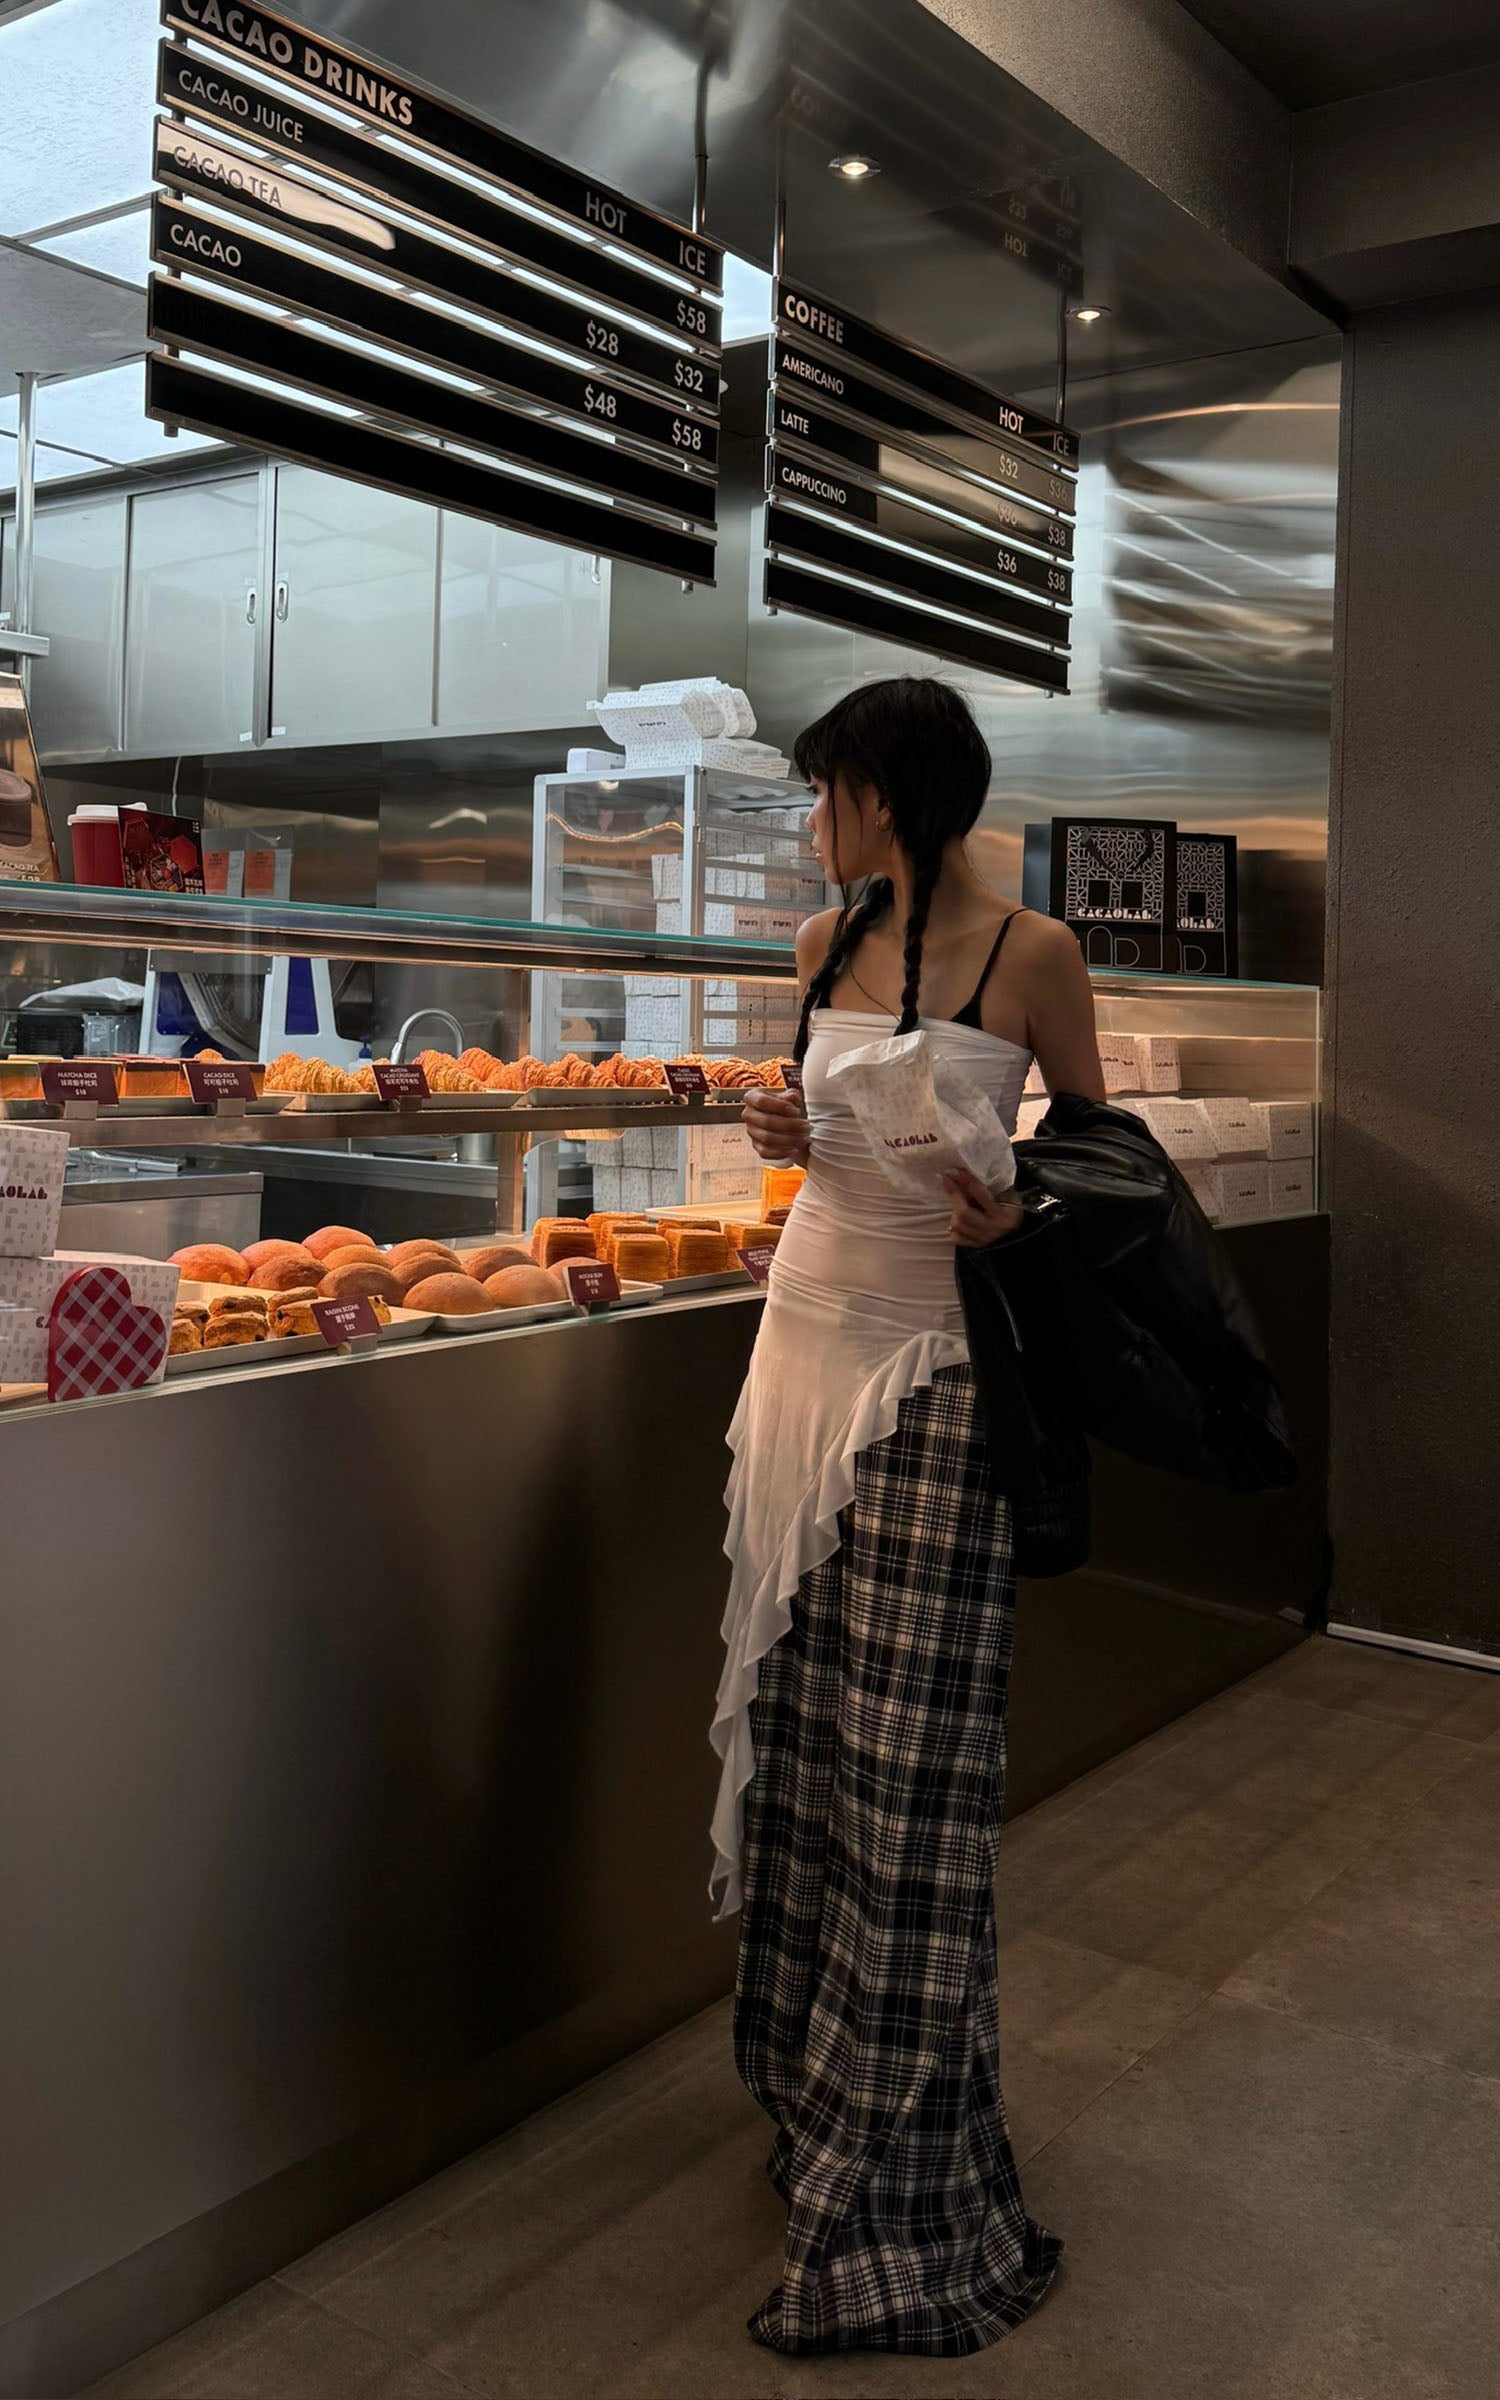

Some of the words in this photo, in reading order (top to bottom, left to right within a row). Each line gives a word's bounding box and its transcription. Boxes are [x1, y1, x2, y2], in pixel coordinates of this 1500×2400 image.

[178, 69, 249, 116] CACAO
[253, 103, 303, 143] JUICE
[677, 299, 706, 334] $58
[181, 0, 293, 64] CACAO
[303, 46, 413, 126] DRINKS
[586, 191, 627, 234] HOT
[679, 240, 705, 275] ICE
[170, 223, 242, 267] CACAO
[584, 384, 617, 418] $48
[672, 419, 701, 450] $58
[174, 146, 243, 189] CACAO
[248, 175, 282, 208] TEA
[586, 320, 619, 356] $28
[674, 360, 704, 392] $32
[782, 353, 844, 395] AMERICANO
[1000, 453, 1018, 479] $32
[1050, 479, 1068, 501] $36
[785, 295, 844, 344] COFFEE
[1000, 406, 1024, 435] HOT
[1053, 432, 1069, 456] ICE
[781, 409, 809, 434] LATTE
[1048, 525, 1066, 547] $38
[782, 467, 846, 504] CAPPUCCINO
[997, 549, 1017, 573] $36
[1048, 570, 1066, 592] $38
[58, 1071, 83, 1079] MATCHA
